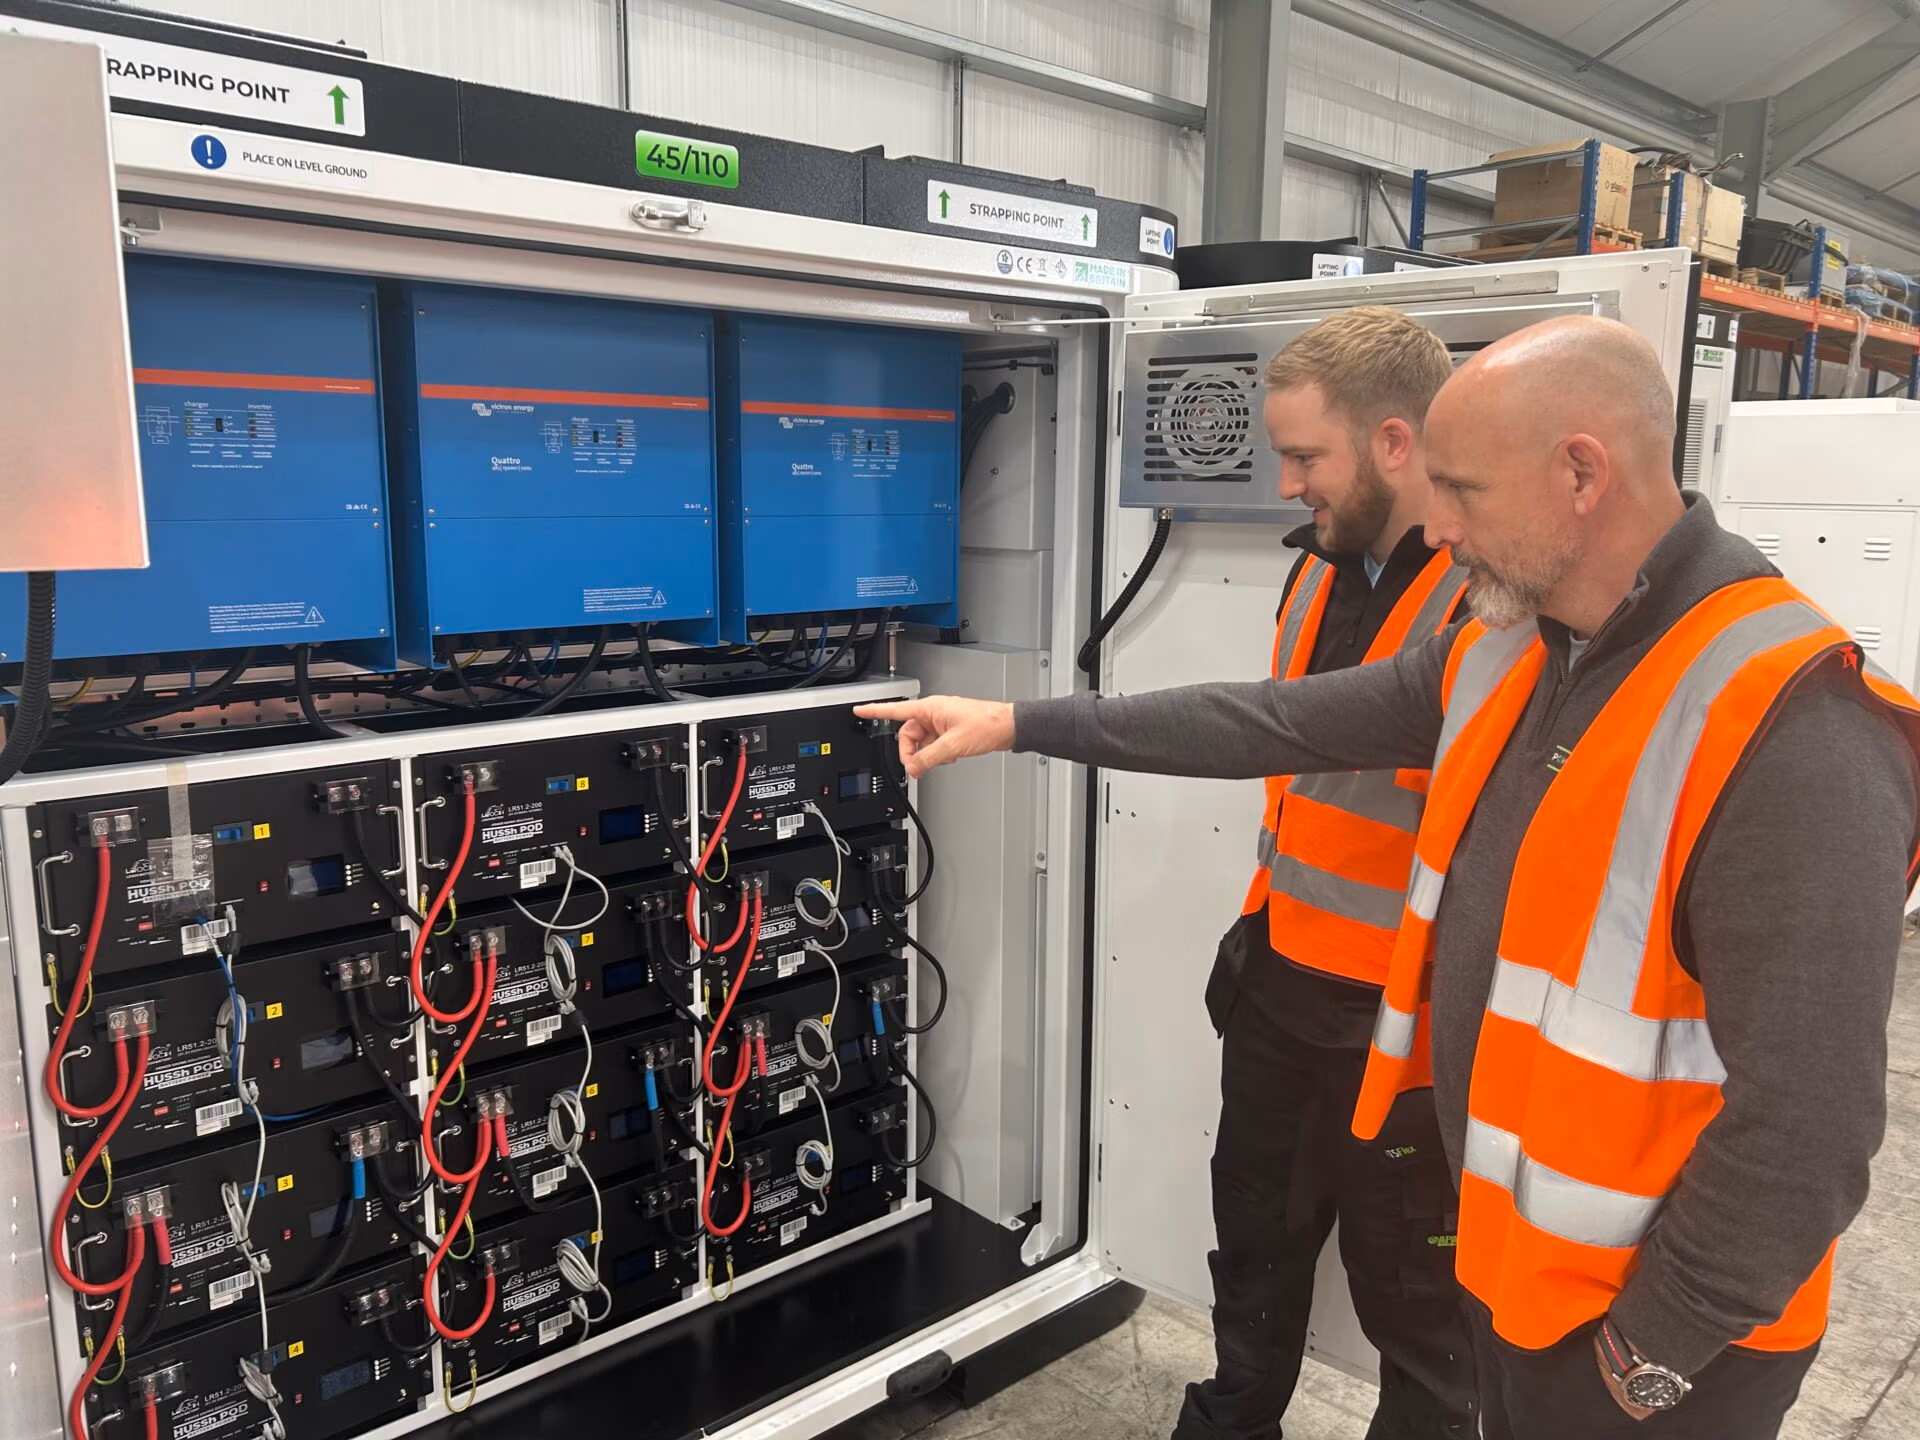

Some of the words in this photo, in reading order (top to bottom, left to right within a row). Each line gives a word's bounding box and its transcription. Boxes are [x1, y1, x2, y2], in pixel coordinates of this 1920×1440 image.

[107, 58, 214, 91] RAPPING
[221, 78, 290, 104] POINT
[243, 151, 275, 166] PLACE
[277, 157, 292, 168] ON
[294, 159, 323, 173] LEVEL
[325, 163, 367, 179] GROUND
[646, 143, 729, 179] 45/110
[969, 204, 1030, 224] STRAPPING
[1033, 215, 1065, 229] POINT
[1090, 263, 1115, 273] MADE
[1117, 266, 1125, 274] IN
[1090, 274, 1125, 288] BRITAIN
[492, 456, 520, 466] Quattro
[749, 786, 776, 796] HUSSh
[778, 782, 796, 790] POD
[508, 802, 542, 813] LR51.2-200
[259, 827, 265, 836] 1
[482, 828, 517, 840] HUSSh
[520, 823, 543, 833] POD
[127, 884, 175, 900] HUSSh
[779, 921, 797, 931] POD
[585, 936, 590, 944] 7
[515, 961, 545, 973] LR51.2-20
[491, 988, 523, 1002] HUSSh
[526, 981, 549, 992] POD
[272, 1007, 278, 1015] 2
[177, 1038, 218, 1052] LR51.2-20
[780, 1057, 797, 1068] POD
[144, 1070, 190, 1087] HUSSh
[193, 1060, 223, 1075] POD
[590, 1087, 595, 1095] 6
[282, 1179, 288, 1187] 3
[781, 1189, 798, 1200] POD
[207, 1235, 236, 1250] POD
[503, 1292, 536, 1309] HUSSh
[538, 1282, 560, 1295] POD
[293, 1345, 299, 1354] 4
[173, 1417, 217, 1438] HUSSh
[219, 1403, 248, 1419] POD
